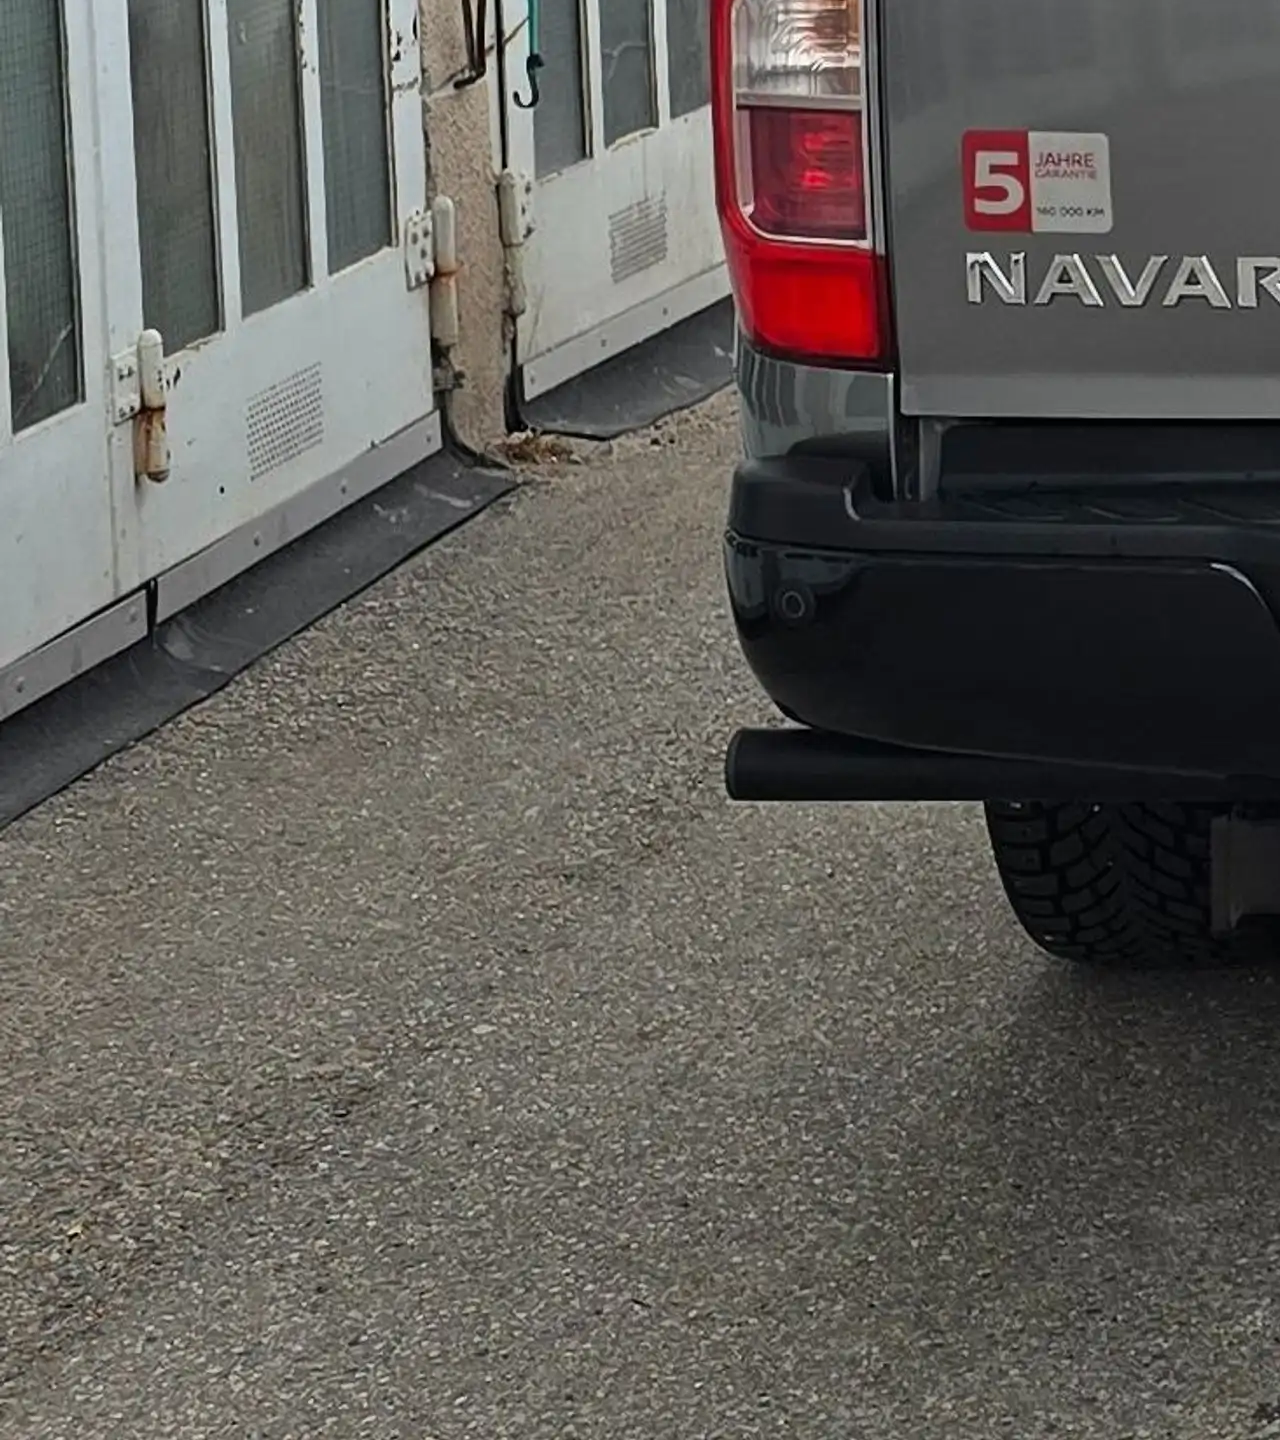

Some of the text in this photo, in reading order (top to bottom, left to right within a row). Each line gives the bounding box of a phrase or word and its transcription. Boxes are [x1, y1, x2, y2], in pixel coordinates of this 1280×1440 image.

[1034, 151, 1095, 169] JAHRE
[974, 150, 1025, 215] 5
[1034, 169, 1098, 180] GARANTIE
